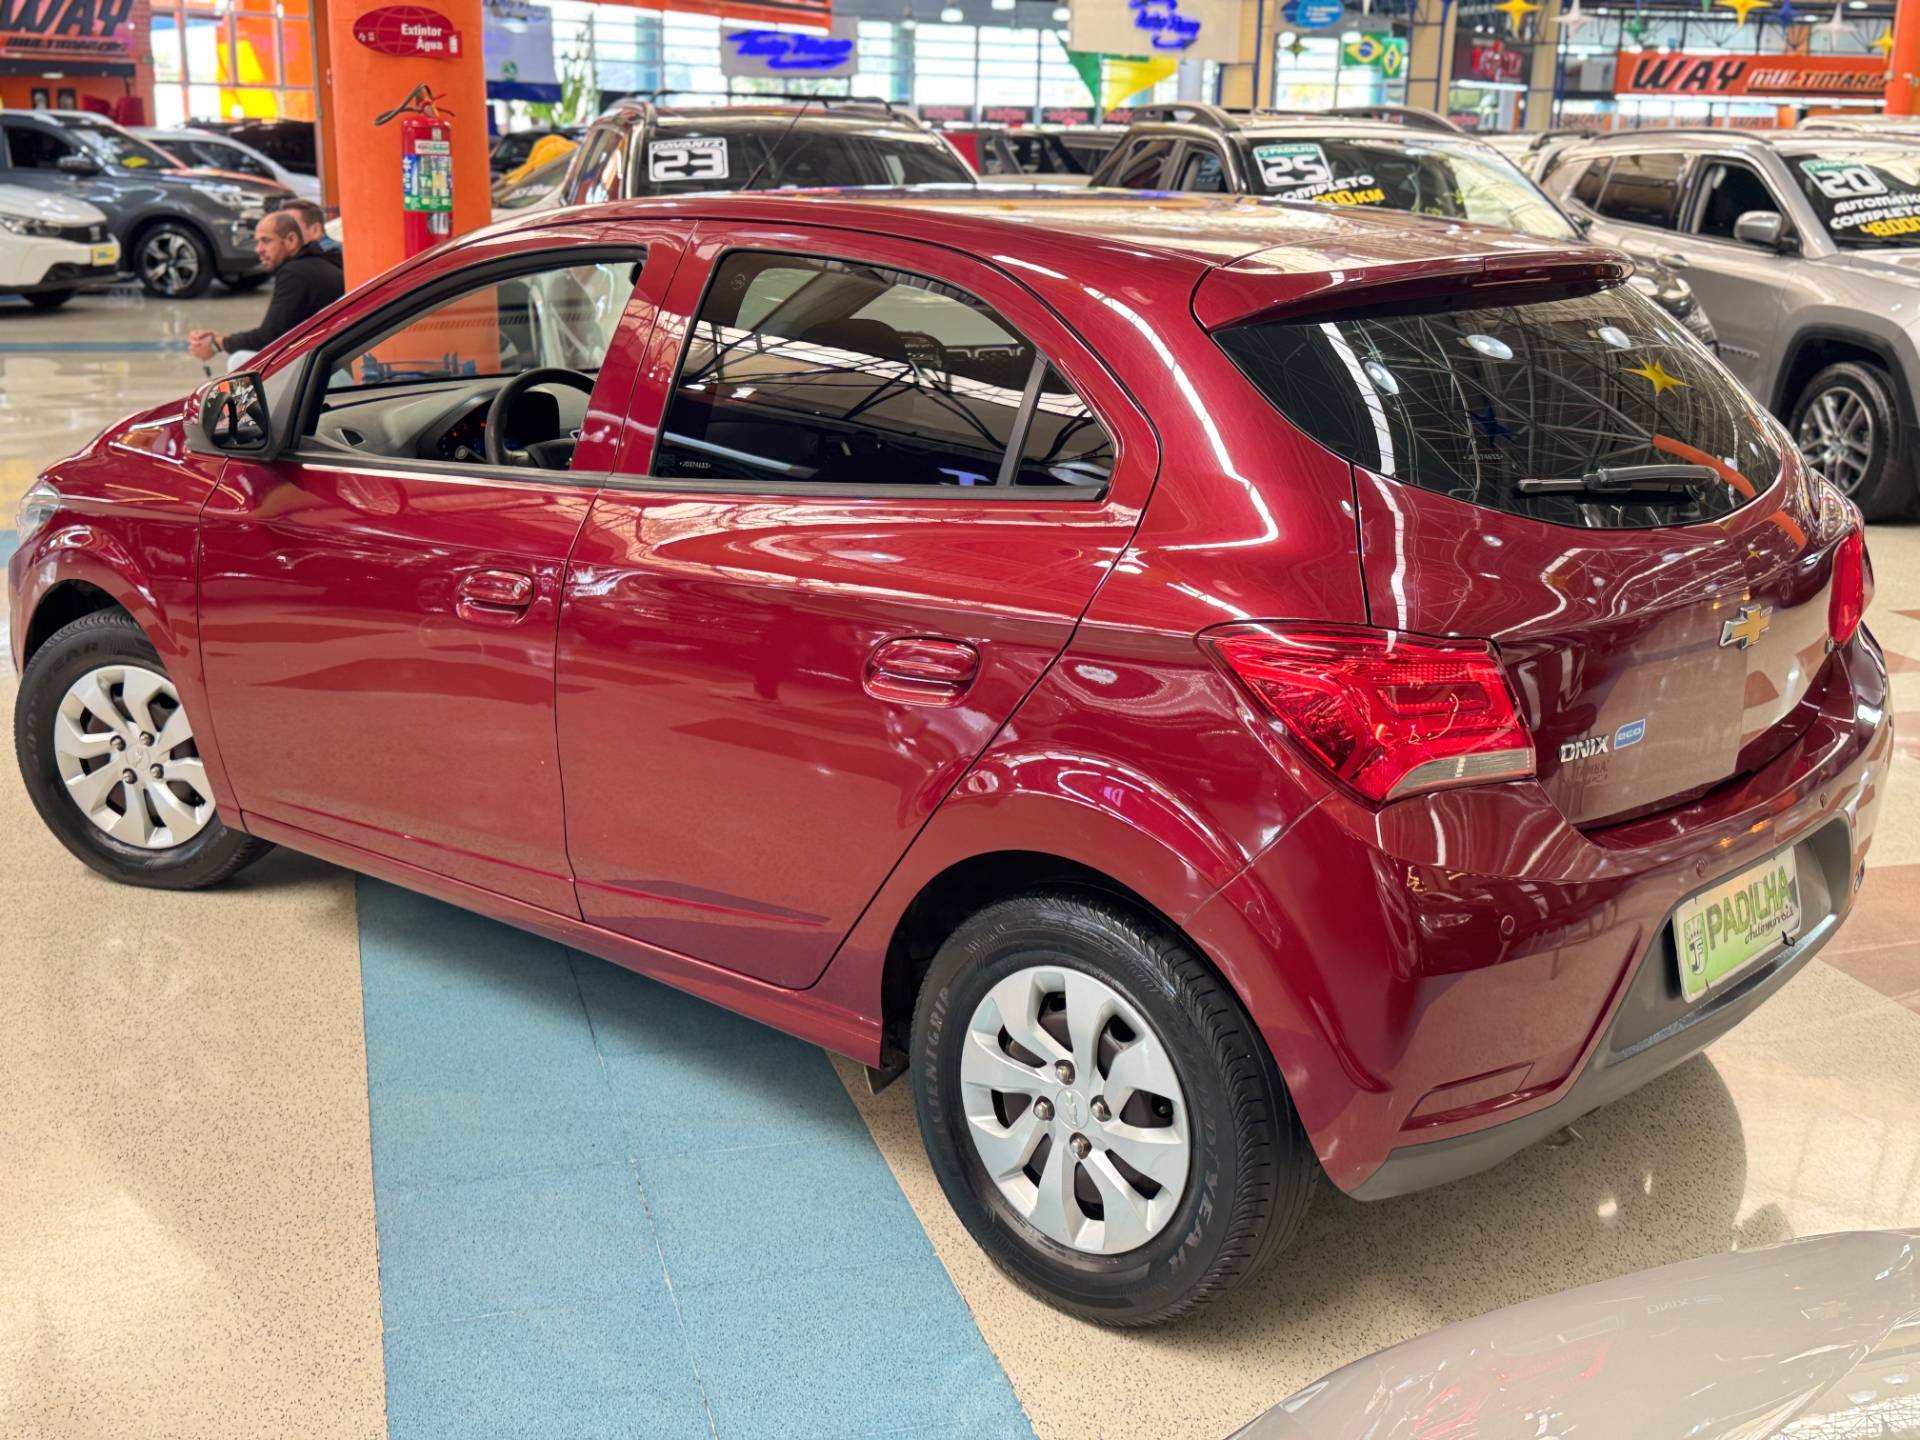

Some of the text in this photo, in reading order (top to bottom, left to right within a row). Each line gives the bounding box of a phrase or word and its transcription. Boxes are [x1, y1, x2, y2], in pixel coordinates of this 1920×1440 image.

[0, 0, 134, 36] WAY
[400, 22, 442, 37] Extintor
[416, 35, 444, 53] Água
[1631, 60, 1747, 91] WAY
[653, 149, 725, 179] 23
[1264, 155, 1329, 184] 25
[1816, 167, 1876, 196] 20
[1706, 865, 1793, 951] PADILHA
